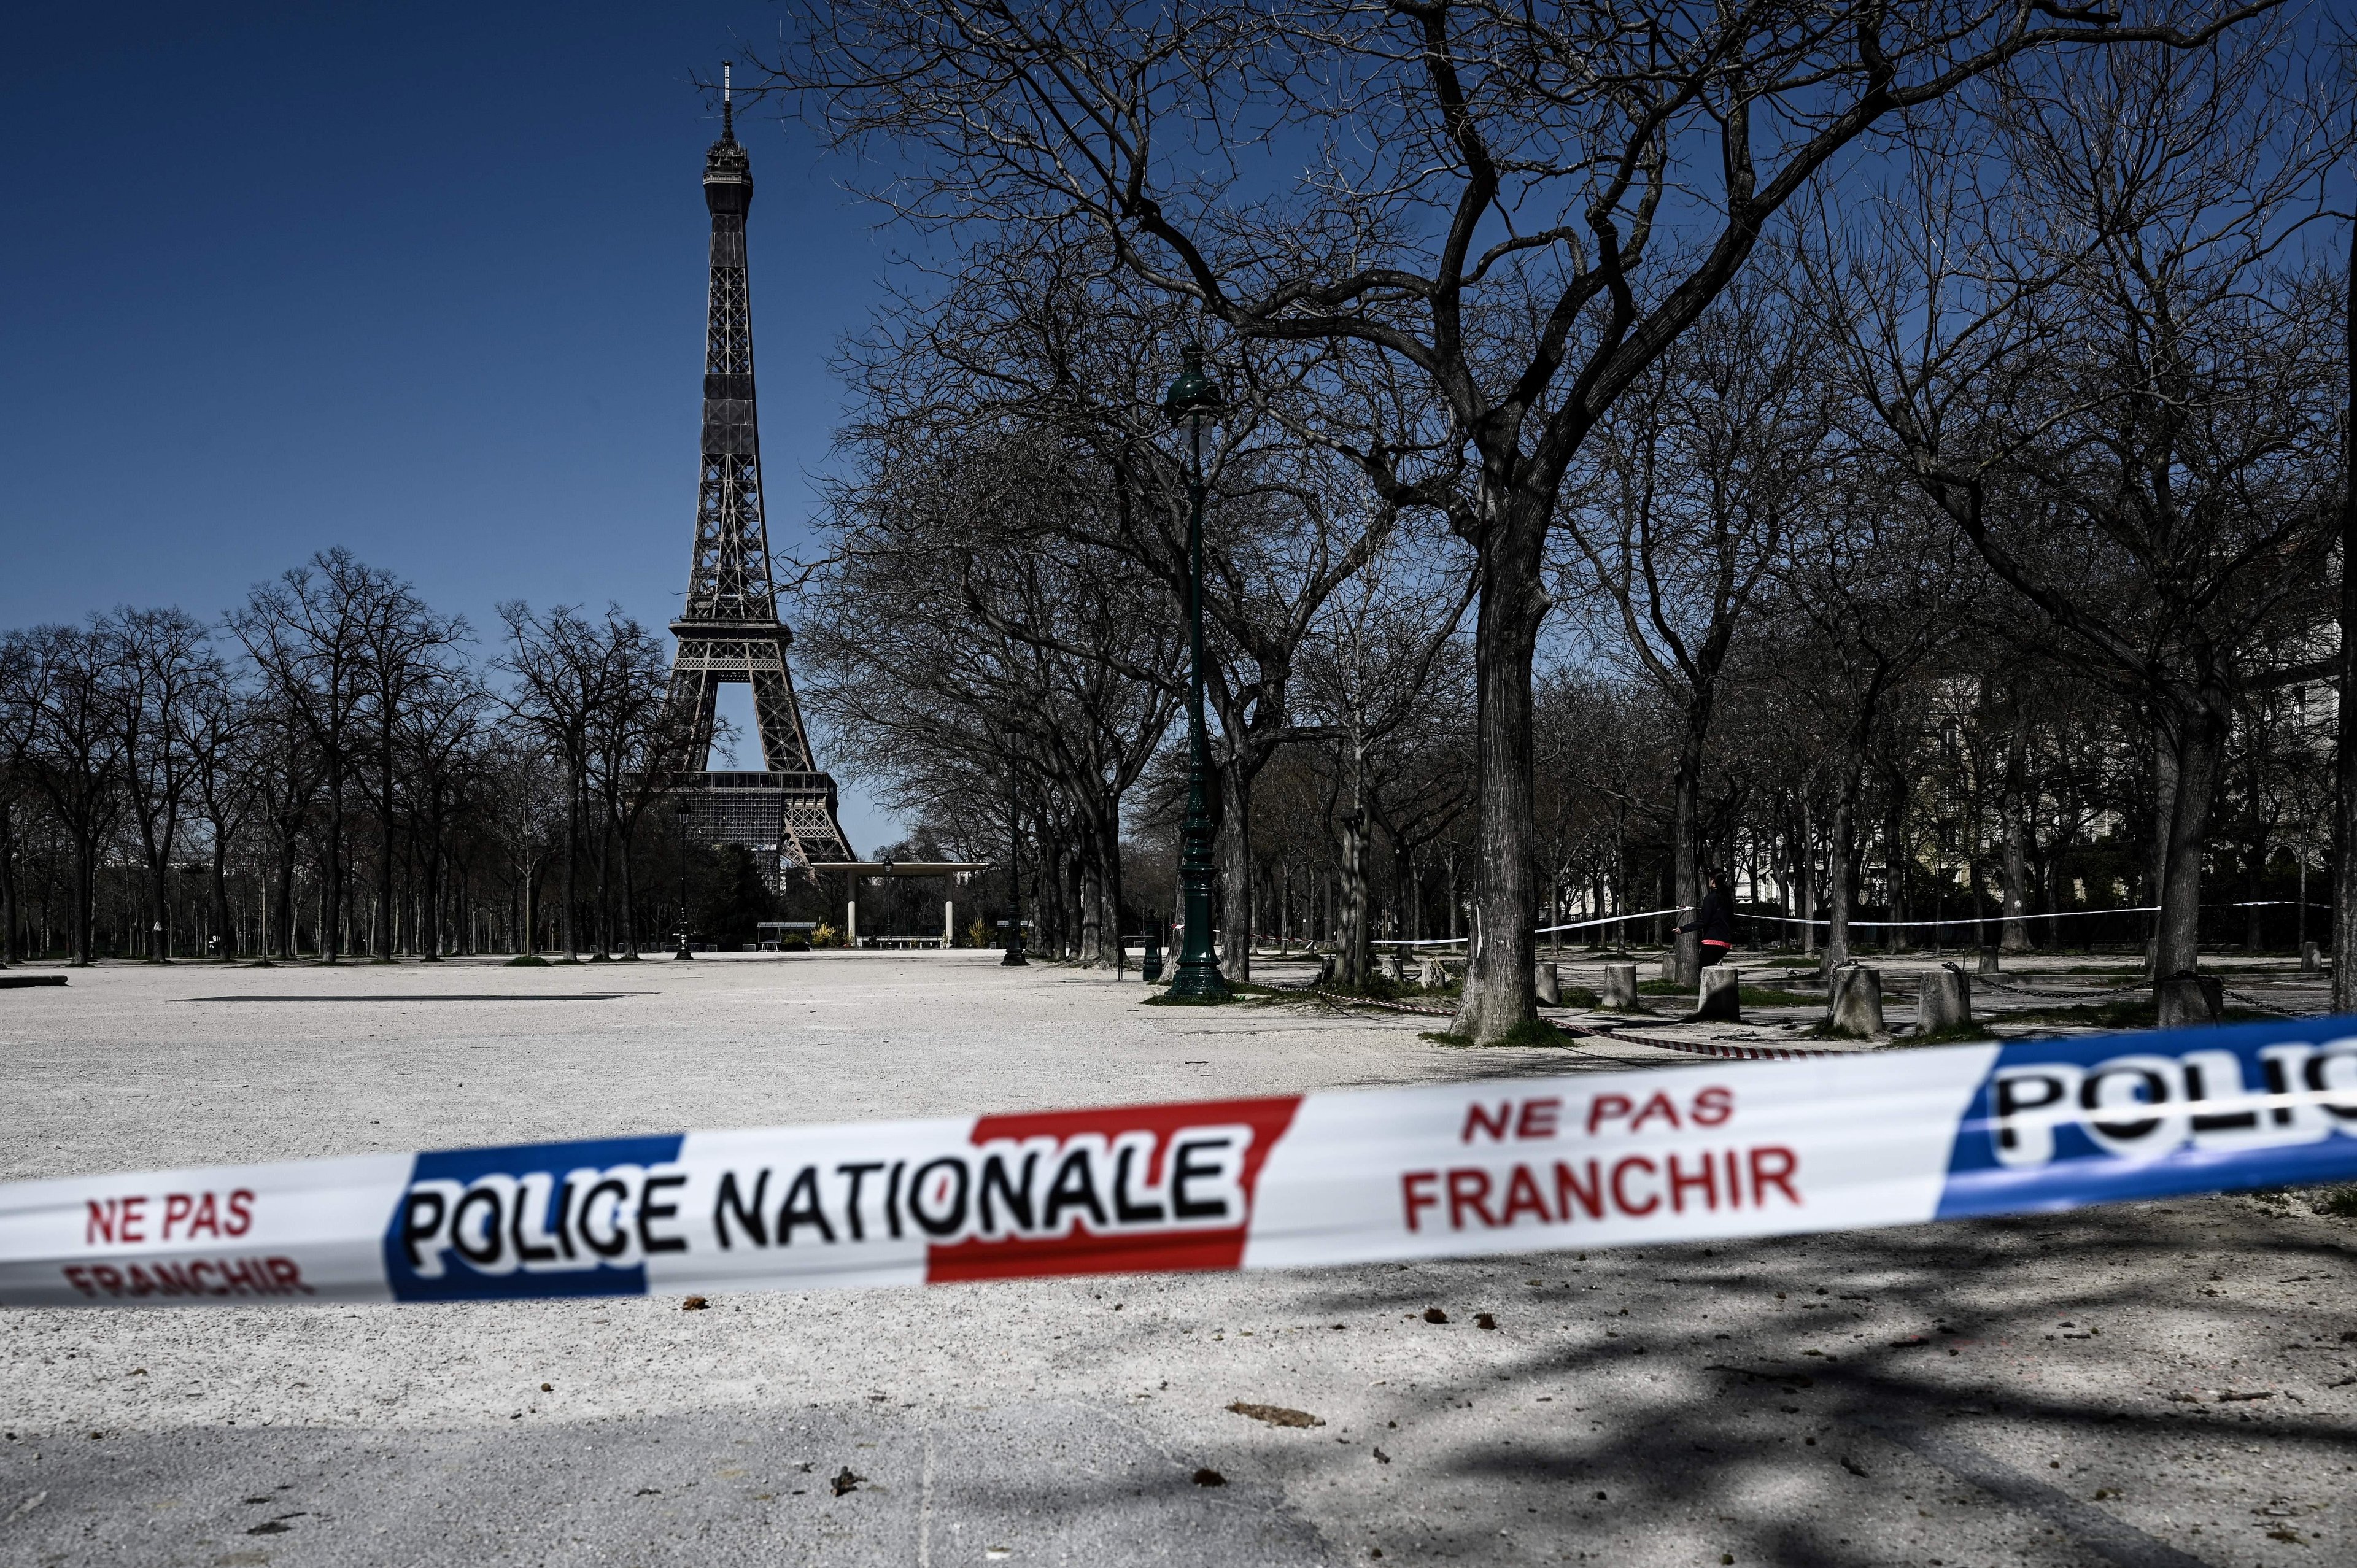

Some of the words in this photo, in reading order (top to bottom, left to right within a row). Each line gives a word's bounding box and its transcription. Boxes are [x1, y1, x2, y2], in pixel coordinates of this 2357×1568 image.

[1461, 1096, 1563, 1143] NE
[1585, 1086, 1737, 1137] PAS
[85, 1197, 147, 1245] NE
[161, 1188, 257, 1241] PAS
[405, 1173, 689, 1266] POLICE
[712, 1137, 1233, 1251] NATIONALE
[1401, 1146, 1803, 1235] FRANCHIR
[61, 1256, 317, 1299] FRANCHIR
